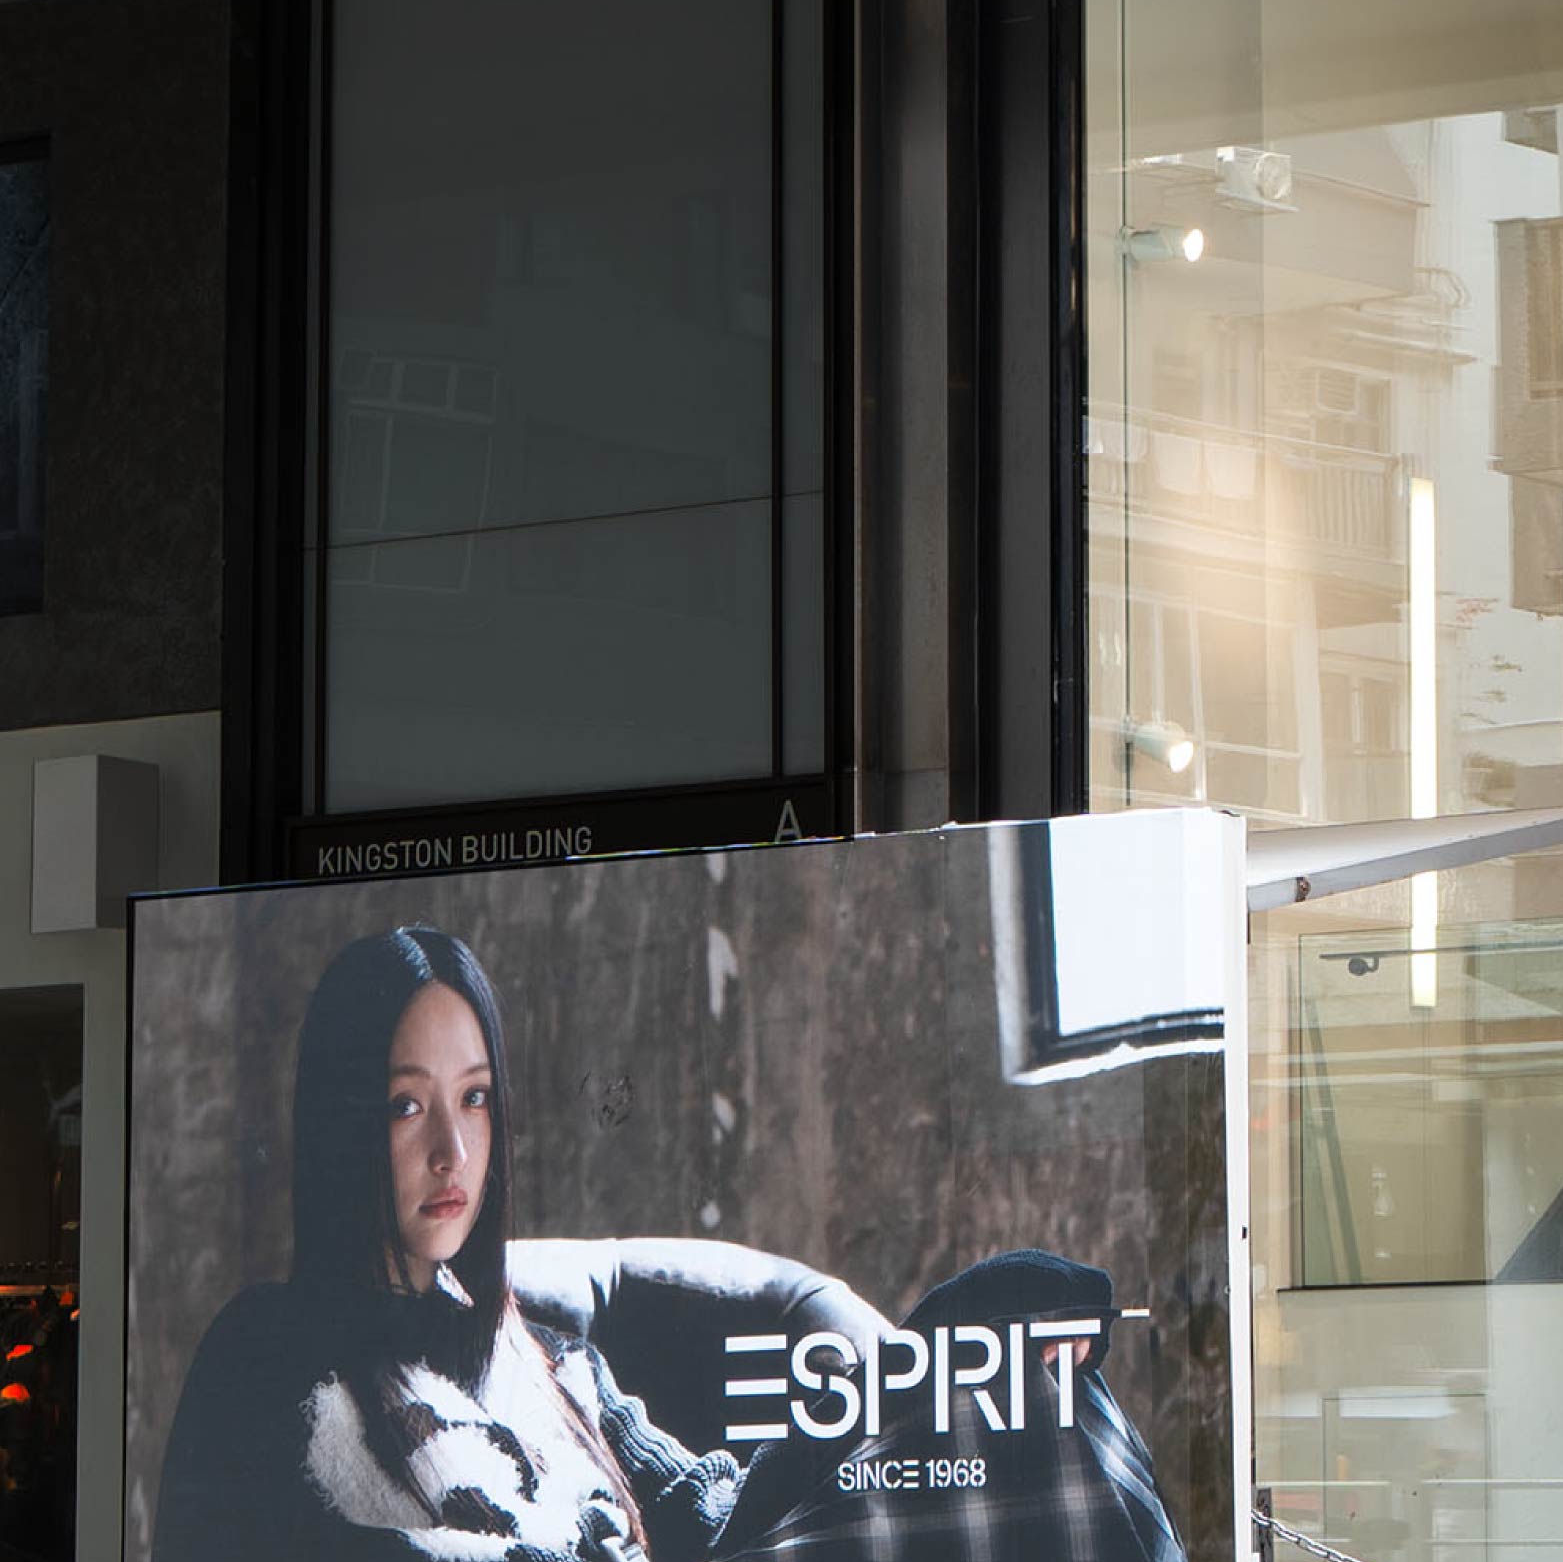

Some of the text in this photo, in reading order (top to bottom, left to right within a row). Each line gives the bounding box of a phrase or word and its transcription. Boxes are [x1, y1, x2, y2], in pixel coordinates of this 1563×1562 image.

[775, 798, 803, 845] A
[317, 826, 594, 875] KINGSTON BUILDING
[725, 1319, 1101, 1441] ESPRIT
[838, 1458, 987, 1491] SINCE 1968
